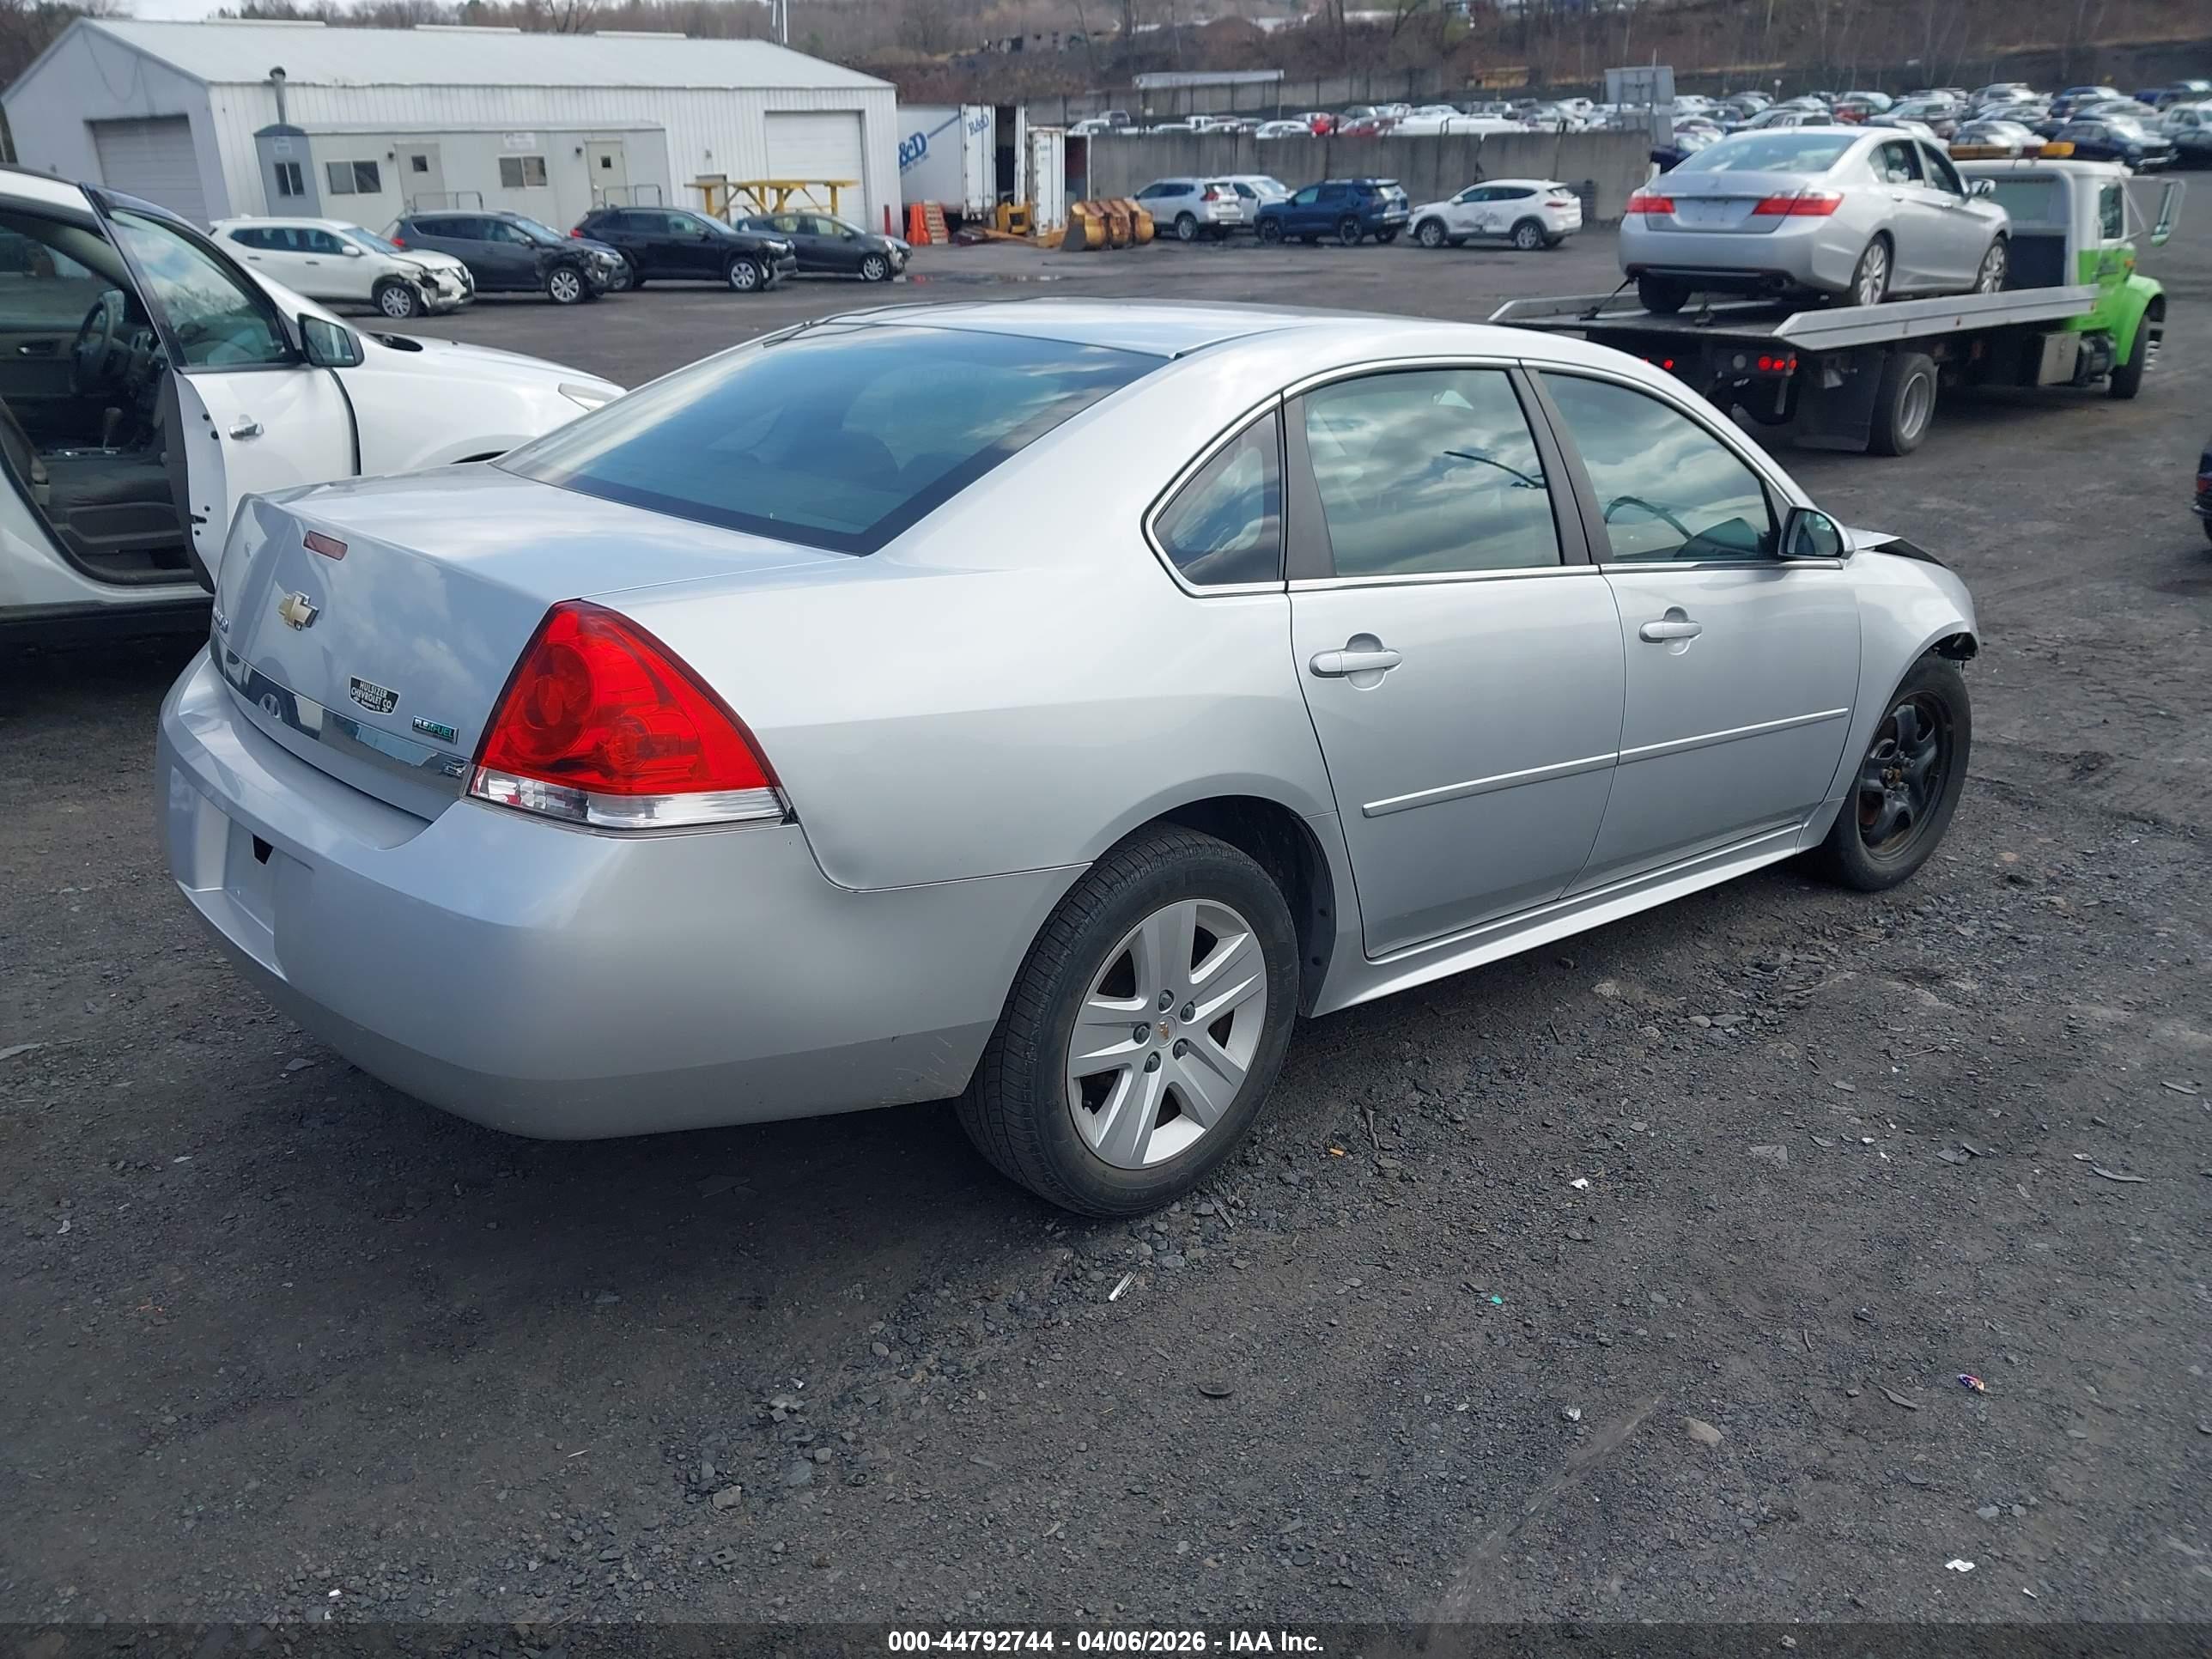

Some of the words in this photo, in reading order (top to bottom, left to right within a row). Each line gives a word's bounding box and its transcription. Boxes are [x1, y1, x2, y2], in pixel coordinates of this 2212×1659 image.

[968, 114, 990, 136] R&D
[899, 131, 928, 169] &D
[350, 686, 383, 706] CHEVROLET
[382, 699, 393, 711] CO.
[359, 681, 388, 699] HULSIZER
